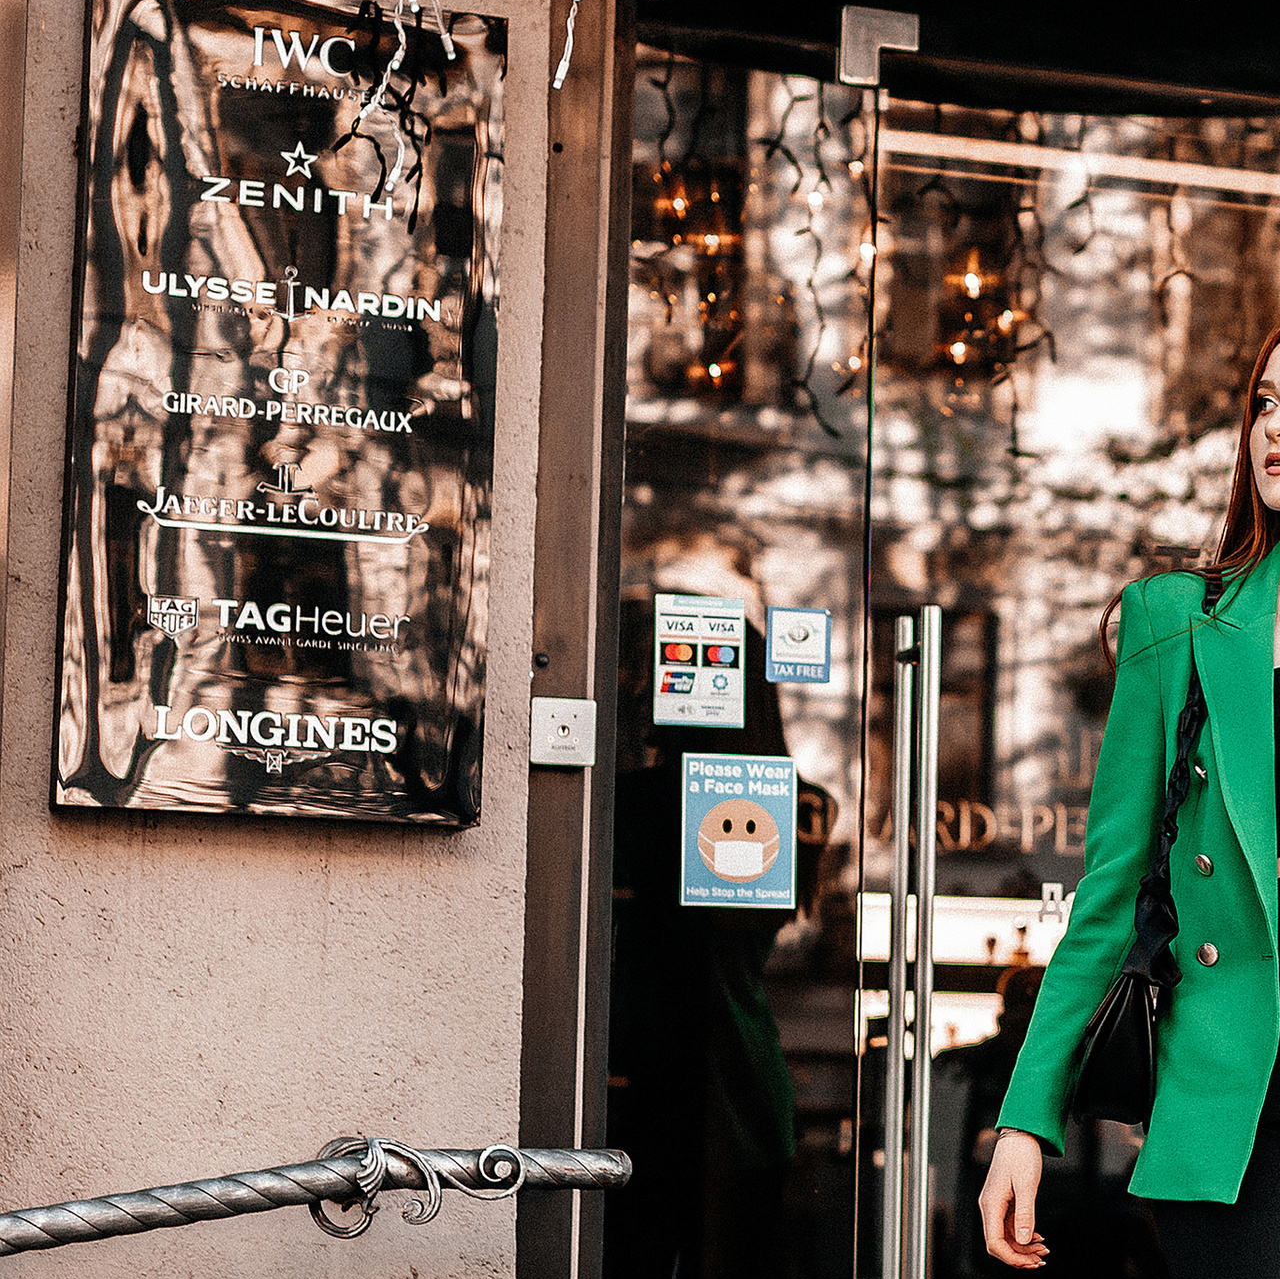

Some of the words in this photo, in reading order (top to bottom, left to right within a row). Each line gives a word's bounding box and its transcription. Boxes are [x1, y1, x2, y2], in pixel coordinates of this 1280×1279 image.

[253, 26, 356, 78] IWC
[200, 176, 394, 221] ZENITH
[142, 270, 277, 305] ULYSSE
[304, 286, 442, 322] NARDIN
[268, 367, 310, 394] GP
[162, 391, 413, 433] GIRARD-PERREGAUX
[154, 599, 192, 612] TAG
[666, 620, 694, 632] VISA
[708, 622, 735, 633] VISA
[773, 664, 794, 677] TAX
[796, 664, 825, 679] FREE
[153, 706, 398, 754] LONGINES
[688, 761, 742, 778] Please
[746, 763, 791, 780] Wear
[689, 780, 700, 793] a
[704, 779, 744, 795] Face
[748, 780, 790, 797] Mask
[686, 886, 710, 898] Help
[711, 887, 735, 899] Stop
[737, 887, 753, 898] the
[755, 888, 790, 900] Spread
